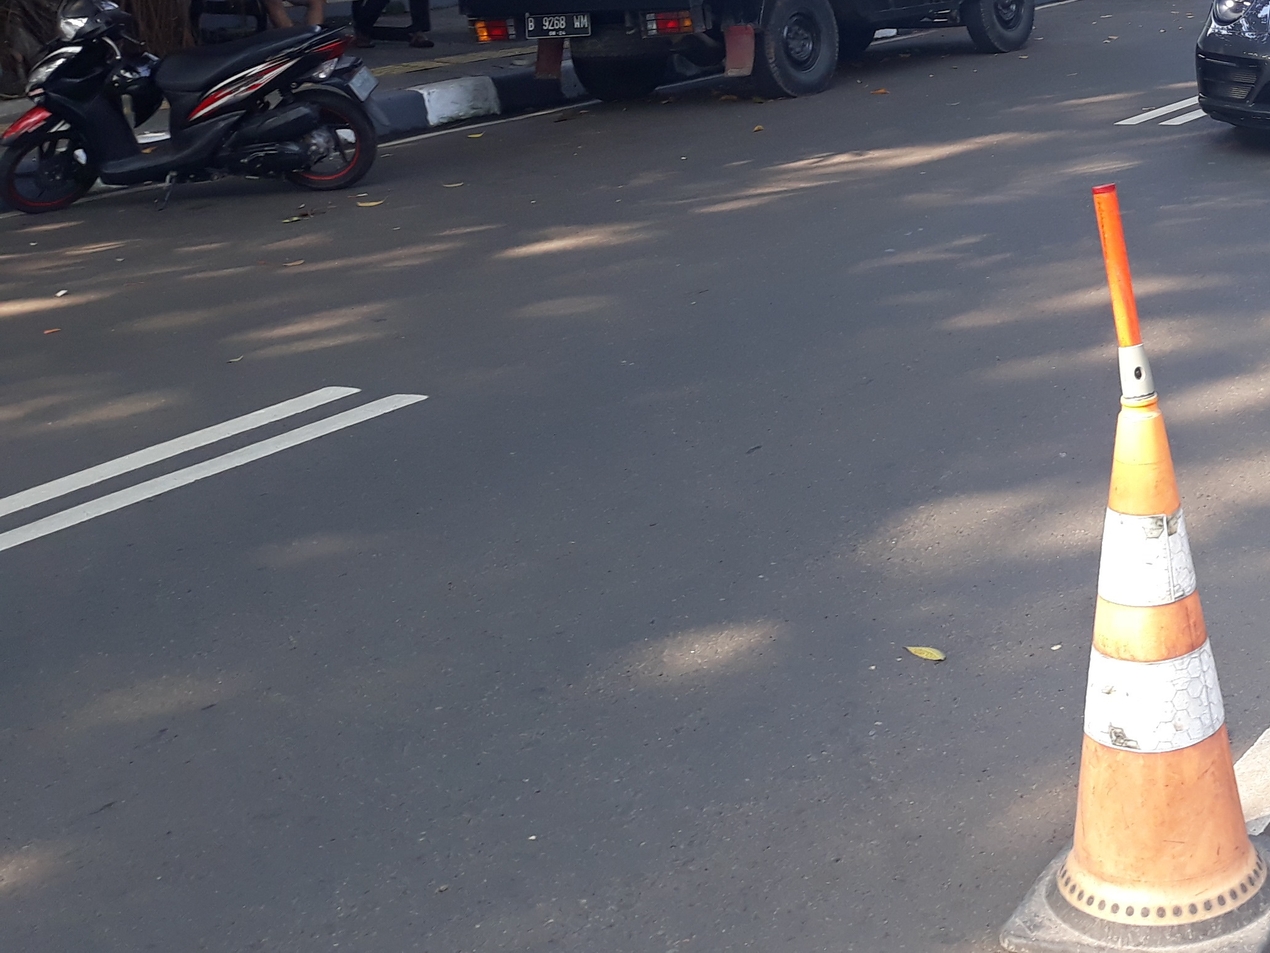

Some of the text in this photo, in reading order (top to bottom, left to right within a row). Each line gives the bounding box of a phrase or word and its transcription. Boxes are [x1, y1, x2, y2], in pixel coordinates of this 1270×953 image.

[528, 15, 588, 31] B 9268 WM
